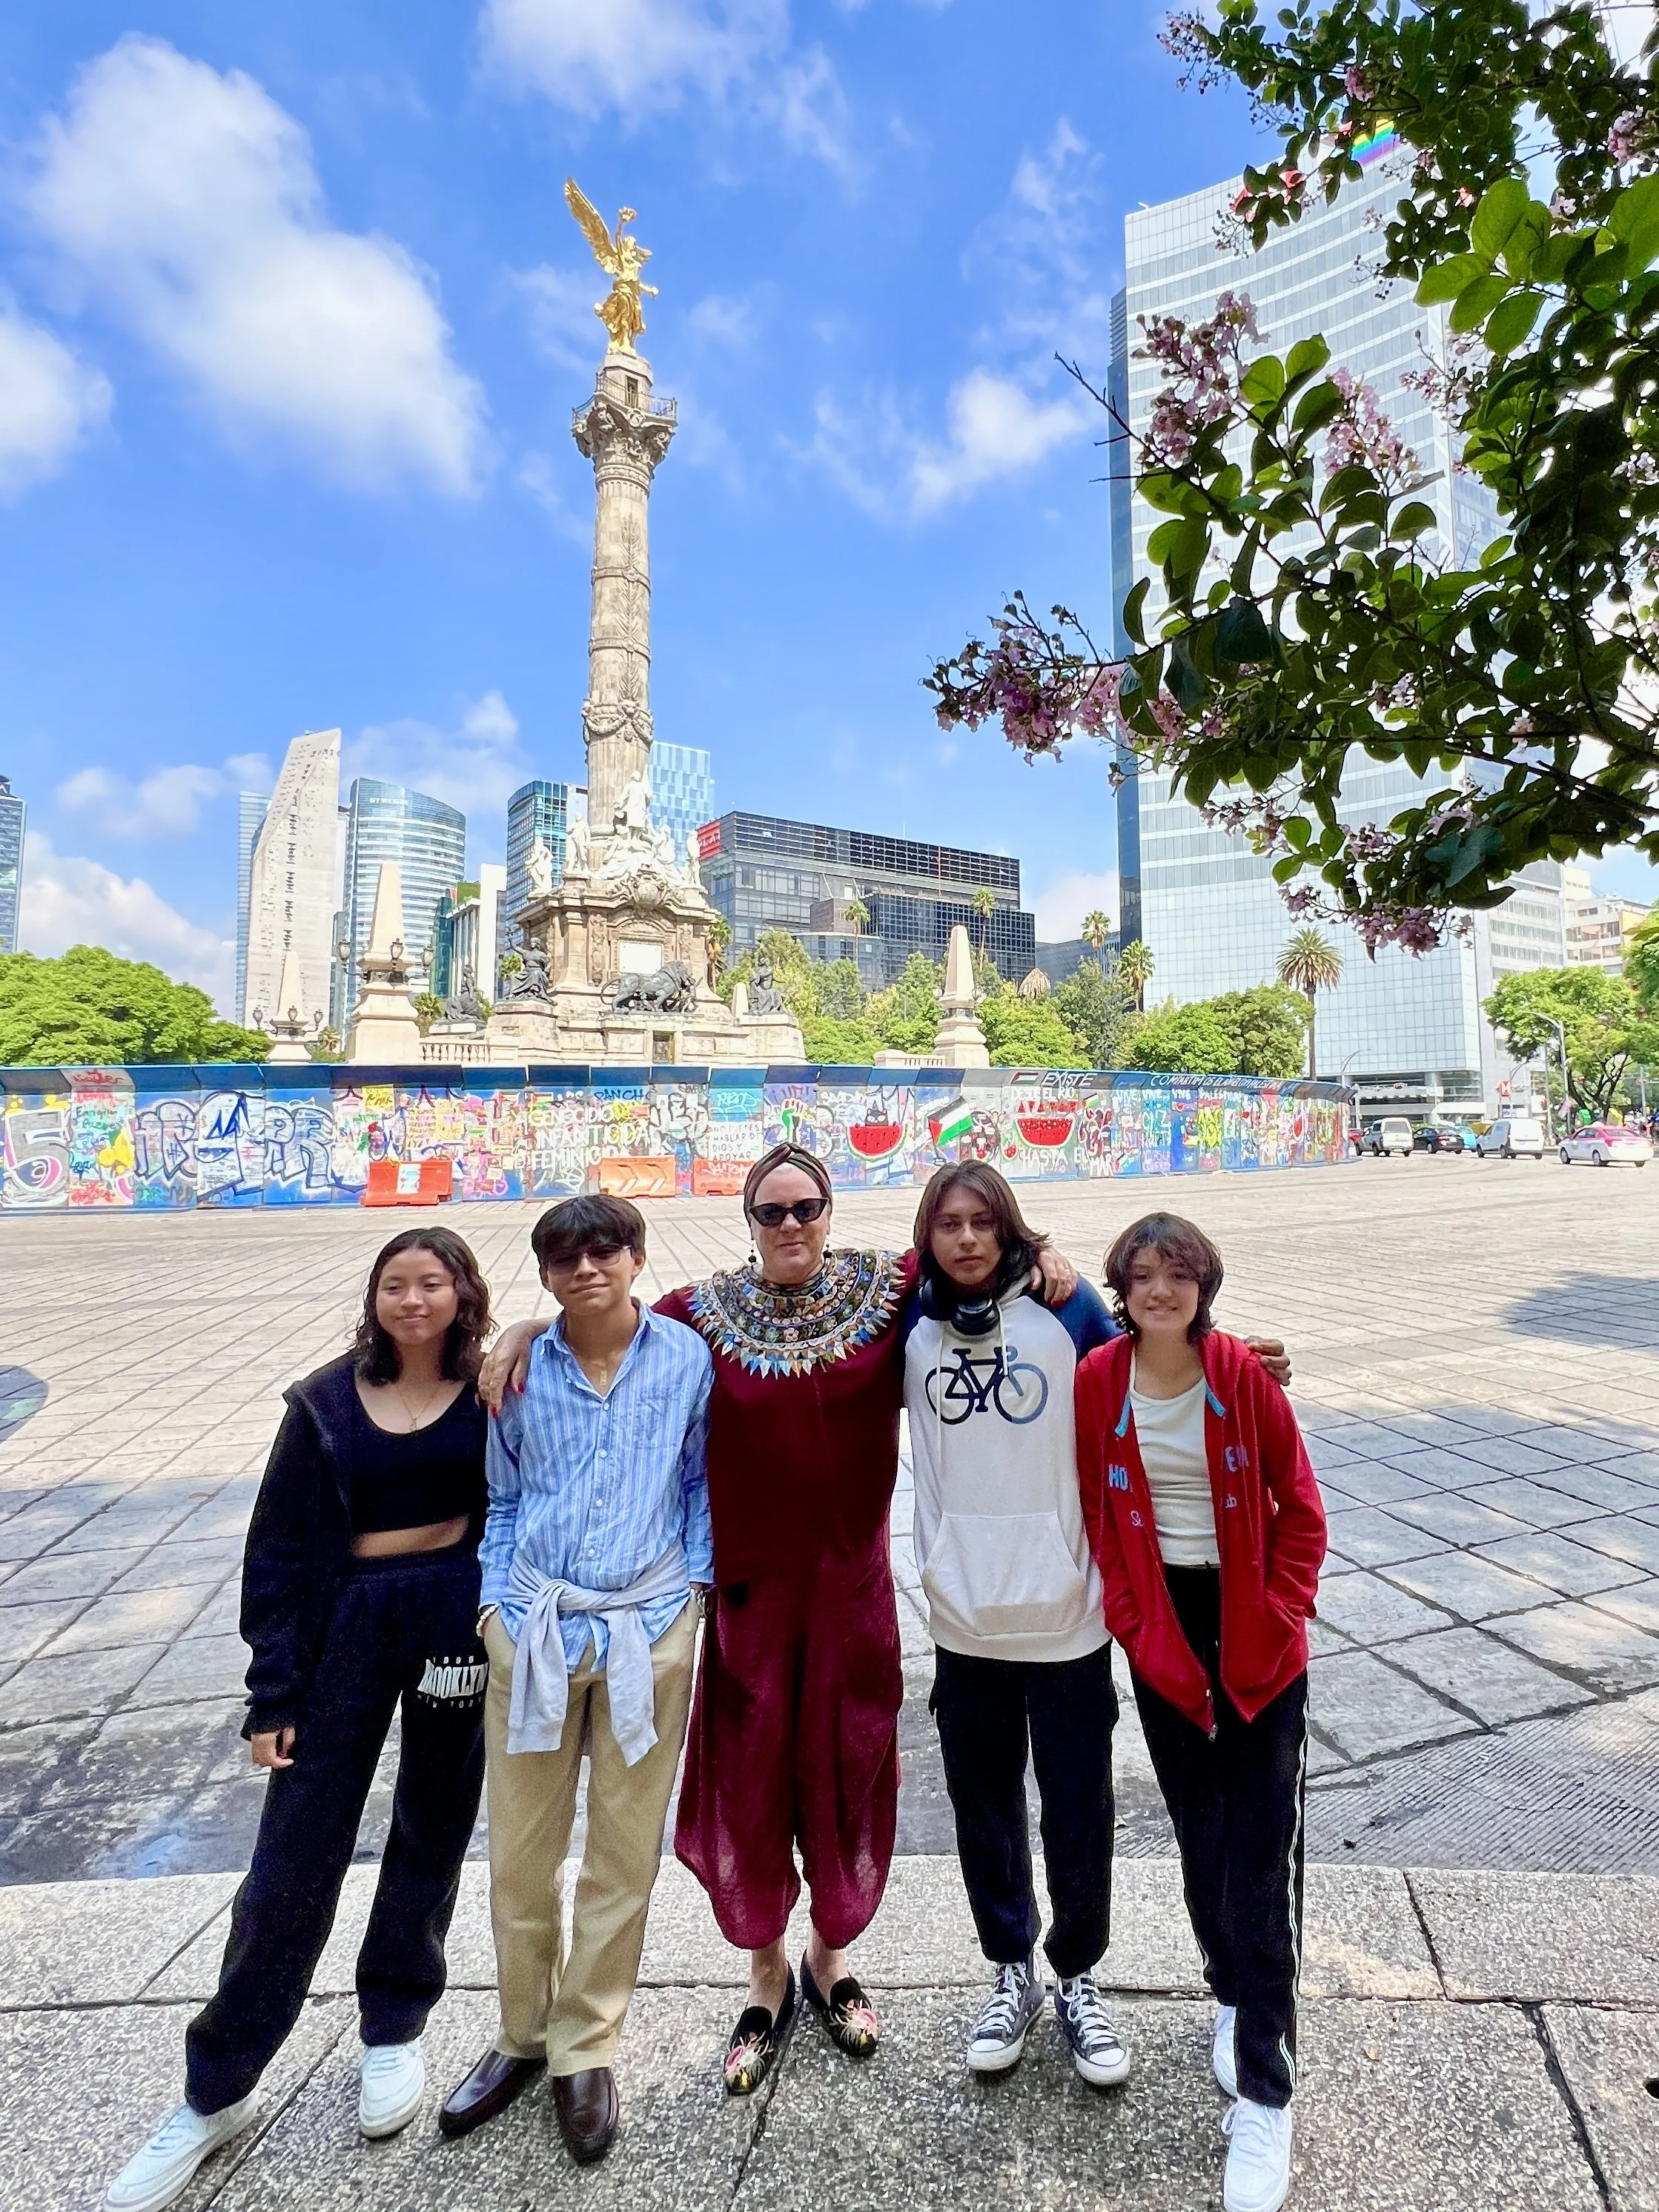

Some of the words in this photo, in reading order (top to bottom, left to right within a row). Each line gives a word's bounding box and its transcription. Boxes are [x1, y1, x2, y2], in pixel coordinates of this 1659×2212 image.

[1042, 1070, 1098, 1087] EXISTE
[1043, 1087, 1056, 1099] EL
[713, 1133, 746, 1142] HABLAR
[712, 1143, 733, 1152] DIOS
[737, 1142, 743, 1151] Y
[713, 1151, 752, 1161] APOYAR
[1023, 1148, 1069, 1168] HASTA
[1090, 1154, 1113, 1176] MAR
